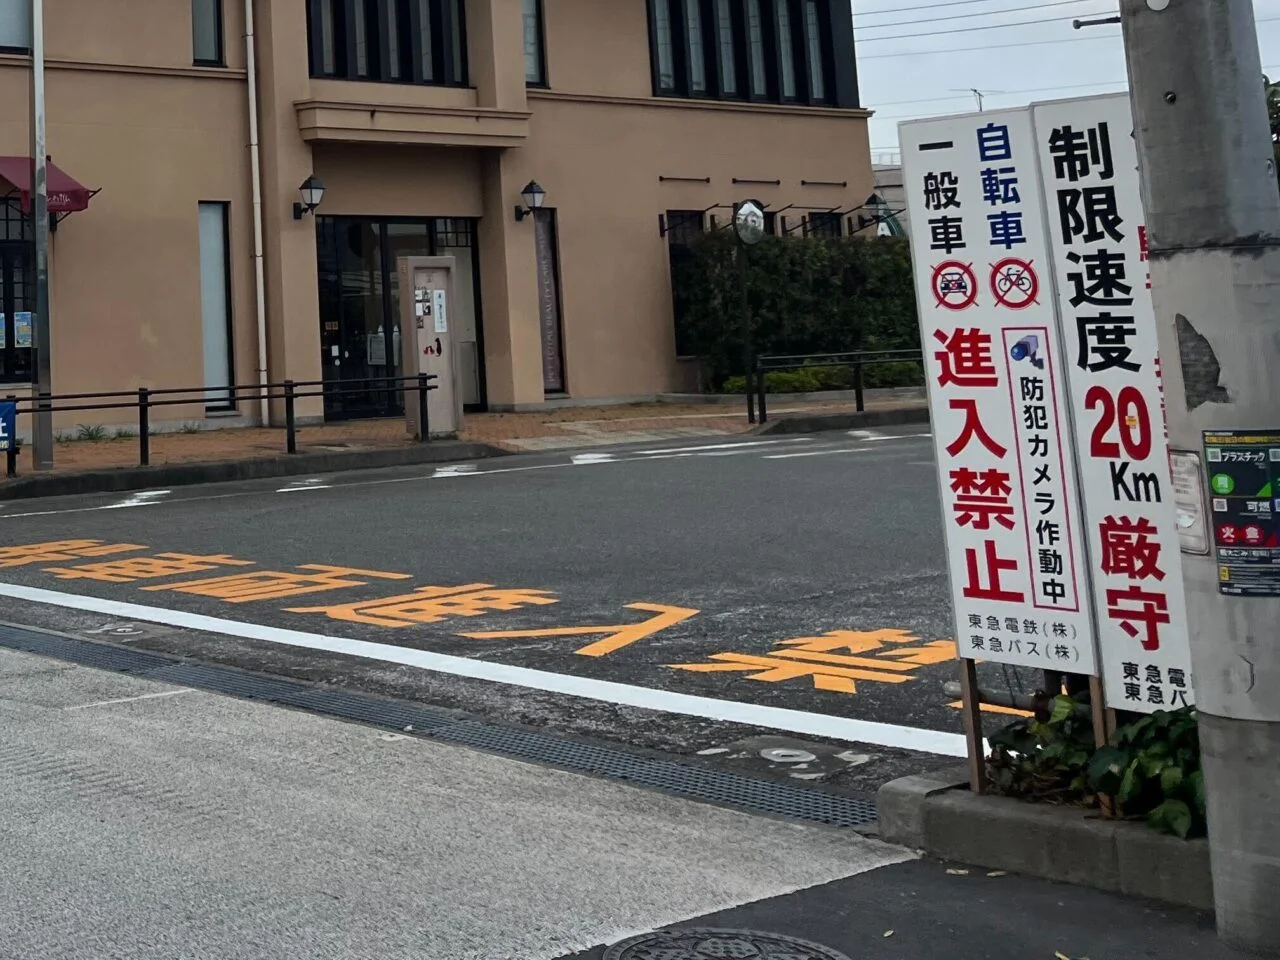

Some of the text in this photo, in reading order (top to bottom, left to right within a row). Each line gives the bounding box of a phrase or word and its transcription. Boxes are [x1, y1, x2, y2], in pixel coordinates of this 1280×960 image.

[919, 140, 966, 254] 一般車
[977, 123, 1026, 249] 自転車
[1049, 122, 1170, 651] 制限速度 20 Km 厳守
[932, 327, 1025, 603] 進入禁止
[1020, 376, 1066, 604] 防犯カメラ作動中
[1222, 451, 1265, 462] プラスチック
[968, 613, 1078, 640] 東急電鉄(株)
[970, 635, 1080, 662] 東急バス(株)
[1122, 661, 1193, 689] 東急電
